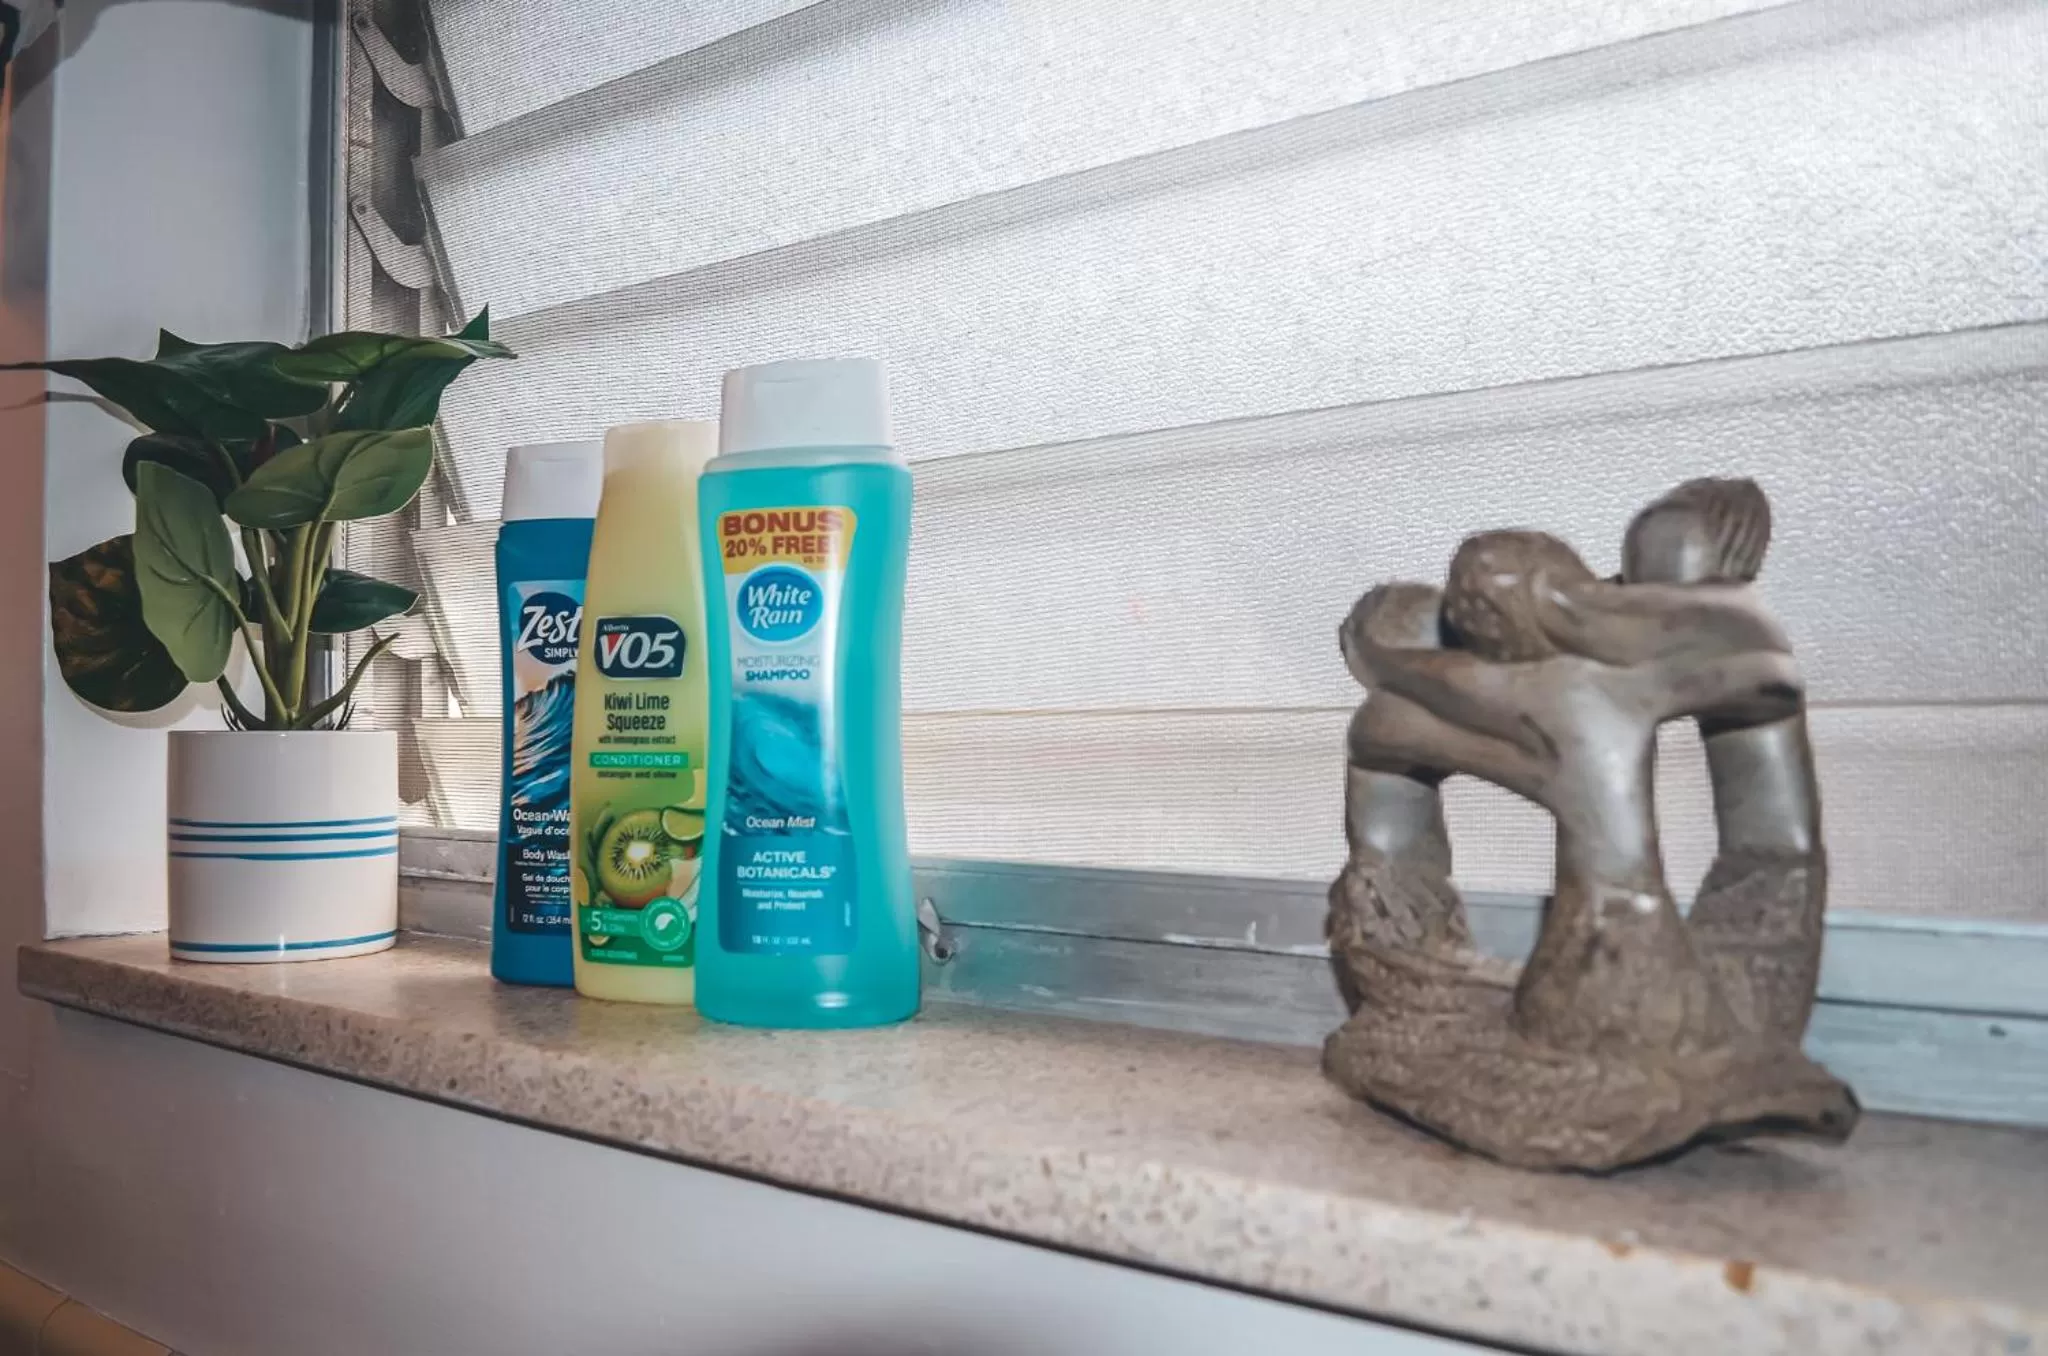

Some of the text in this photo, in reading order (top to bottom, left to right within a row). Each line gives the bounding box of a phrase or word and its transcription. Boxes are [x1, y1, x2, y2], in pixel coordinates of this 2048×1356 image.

[723, 510, 843, 536] BONUS
[725, 534, 830, 558] 20% FREE
[747, 583, 812, 607] White
[749, 607, 802, 629] Rain
[518, 605, 584, 651] Zest
[543, 647, 579, 659] SIMPLY
[600, 631, 679, 669] VO5
[737, 654, 819, 668] MOISTURIZING
[745, 669, 810, 681] SHAMPOO
[604, 692, 670, 710] Kiwi Lime
[607, 713, 666, 733] Squeeze
[593, 754, 681, 766] CONDITIONER
[517, 825, 543, 836] Vague
[746, 815, 816, 829] Ocean Mist
[522, 848, 545, 861] Body
[753, 851, 807, 863] ACTIVE
[590, 910, 602, 931] 5
